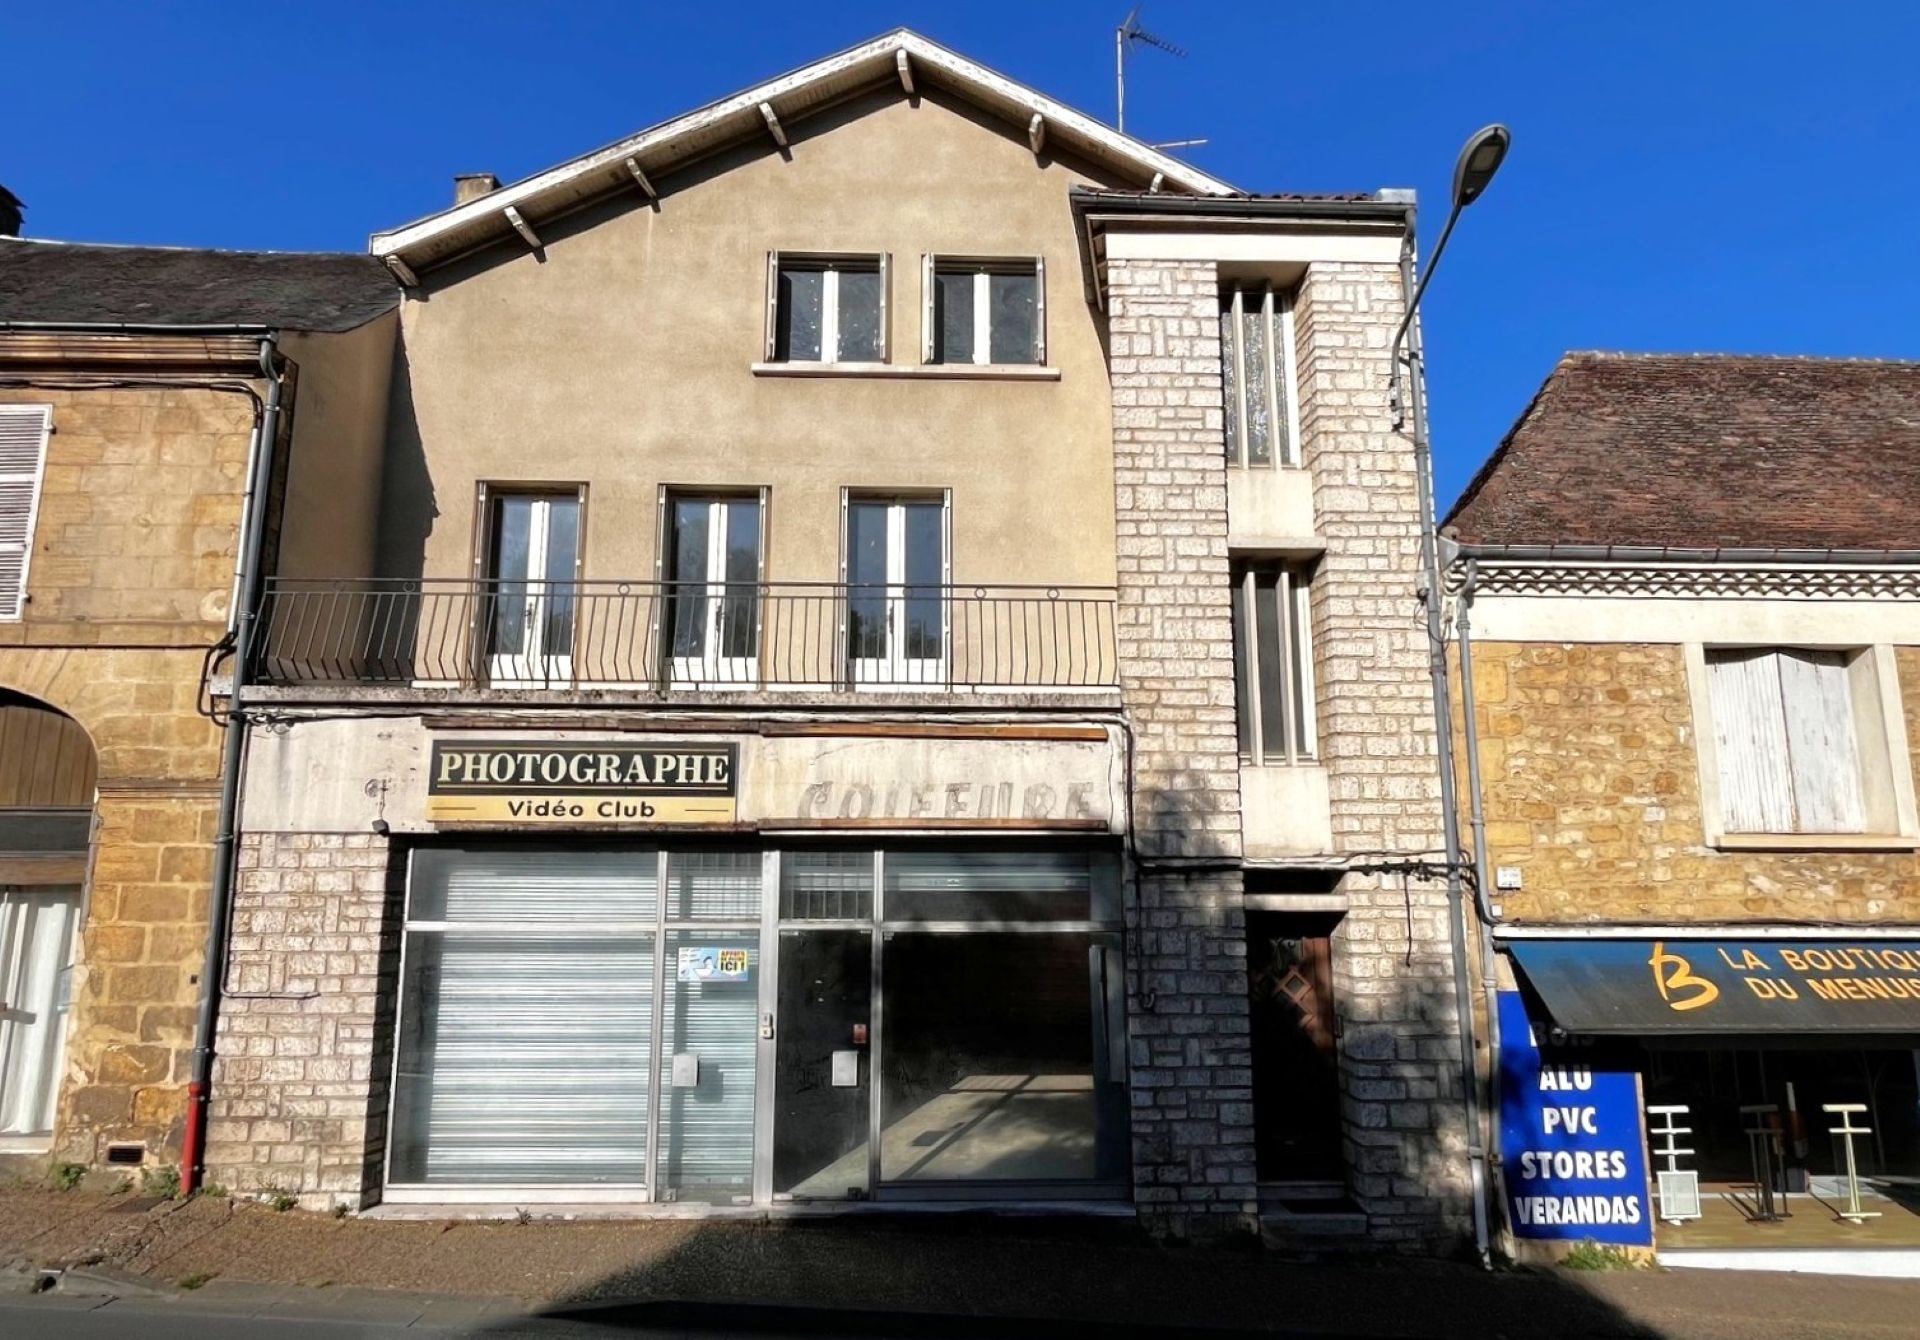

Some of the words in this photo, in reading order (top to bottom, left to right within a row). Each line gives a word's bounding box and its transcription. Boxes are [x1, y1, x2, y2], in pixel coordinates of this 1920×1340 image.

[437, 753, 729, 784] PHOTOGRAPHE
[507, 800, 584, 817] Vidéo
[597, 801, 656, 818] Club
[1717, 948, 1771, 970] LA
[1743, 977, 1799, 999] DU
[1539, 1063, 1593, 1091] ALU
[1543, 1107, 1598, 1135] PVC
[1520, 1150, 1627, 1180] STORES
[1514, 1196, 1642, 1225] VERANDAS
